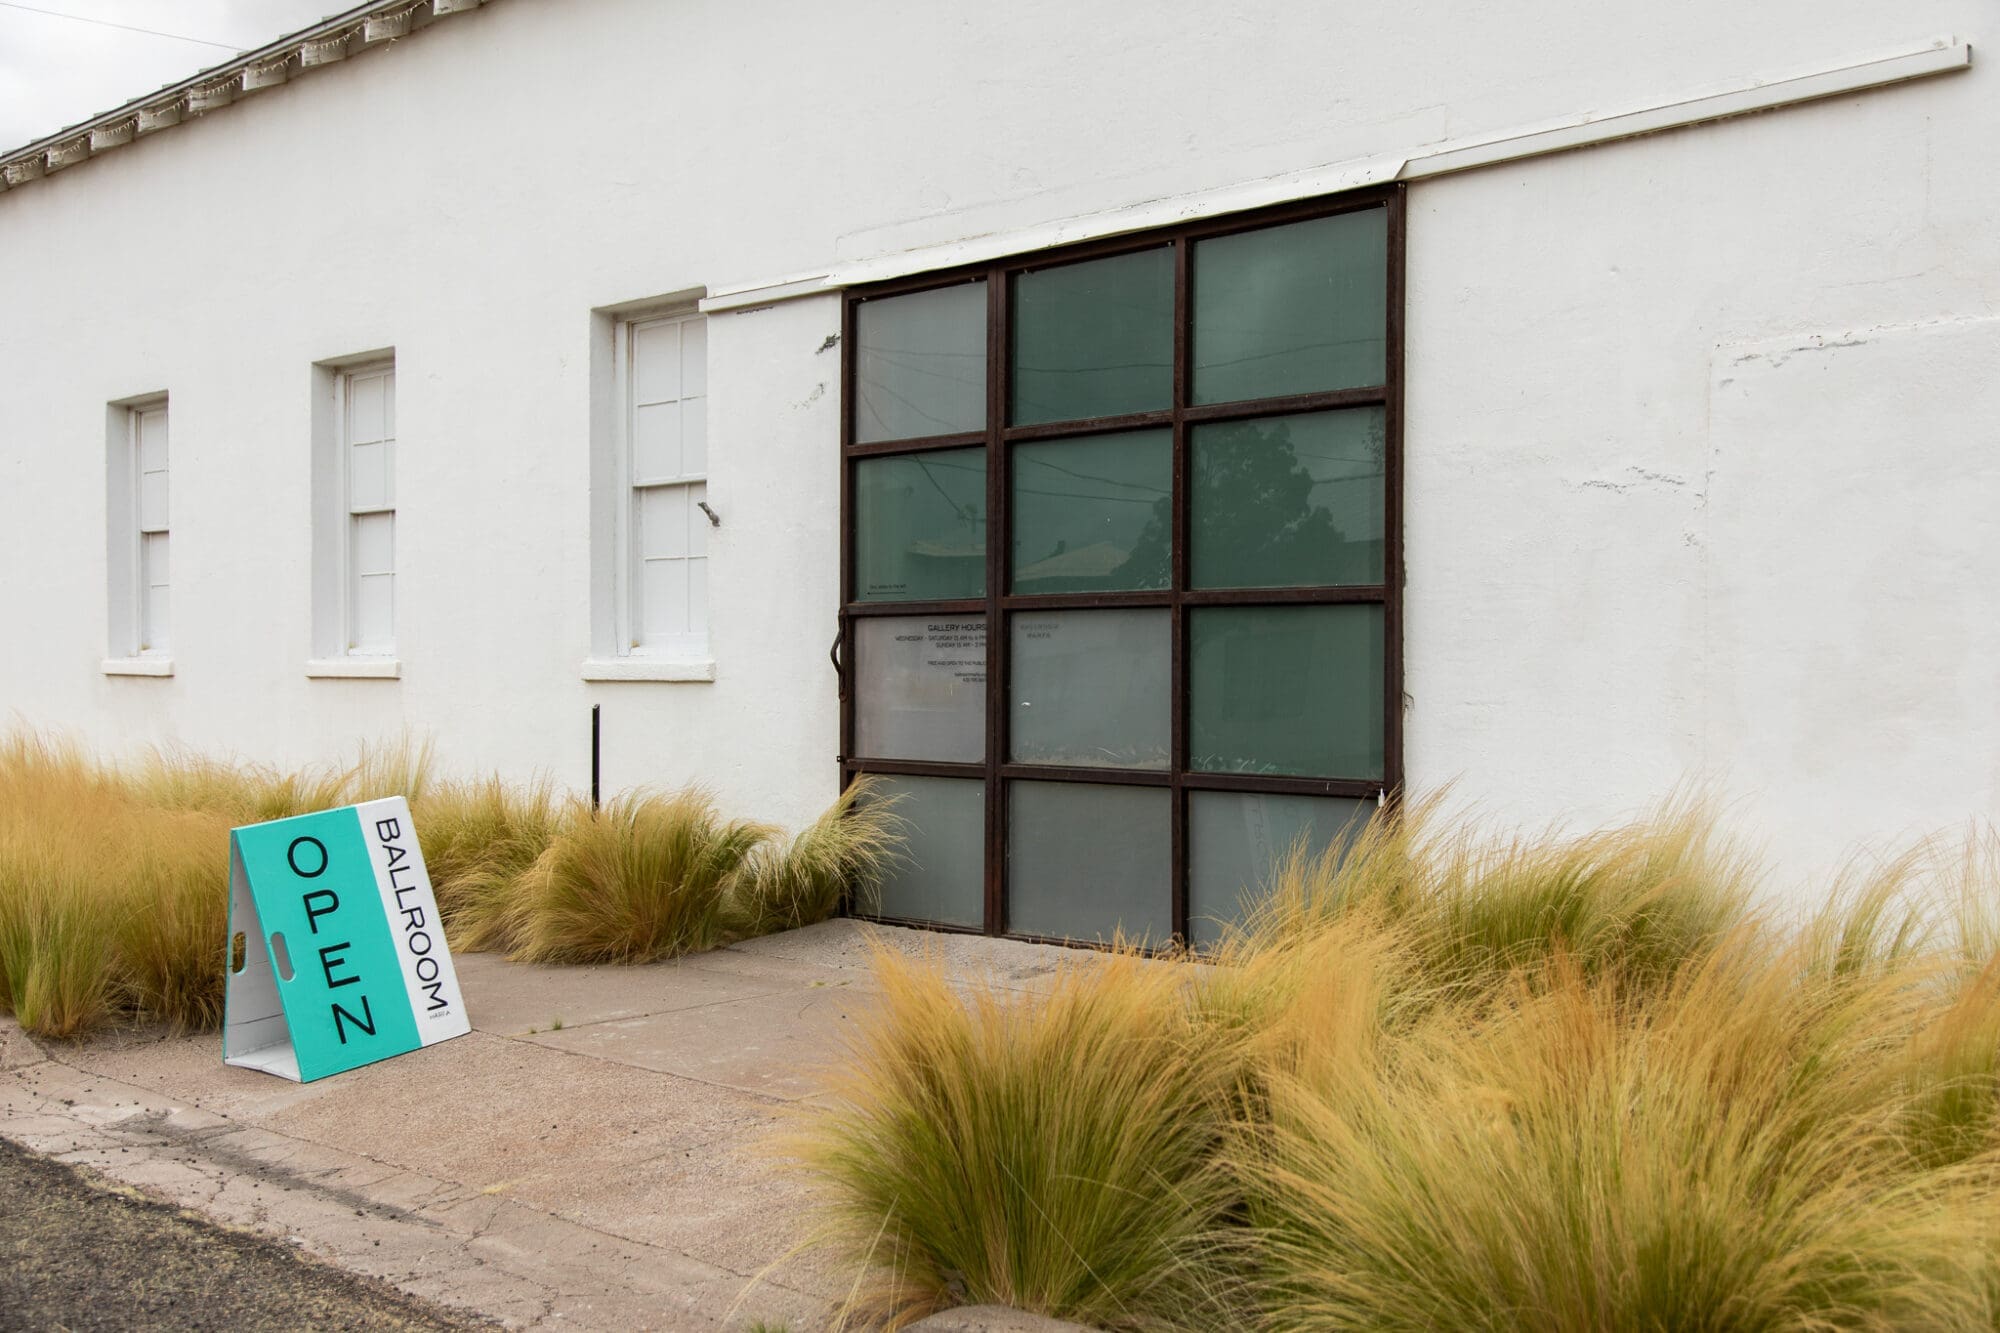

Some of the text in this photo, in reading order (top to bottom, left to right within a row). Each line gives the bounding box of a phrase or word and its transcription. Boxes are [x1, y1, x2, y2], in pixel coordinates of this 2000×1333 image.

[927, 623, 987, 632] GALLERY HOURS
[287, 836, 376, 1045] OPEN
[376, 817, 449, 1012] BALLROOM
